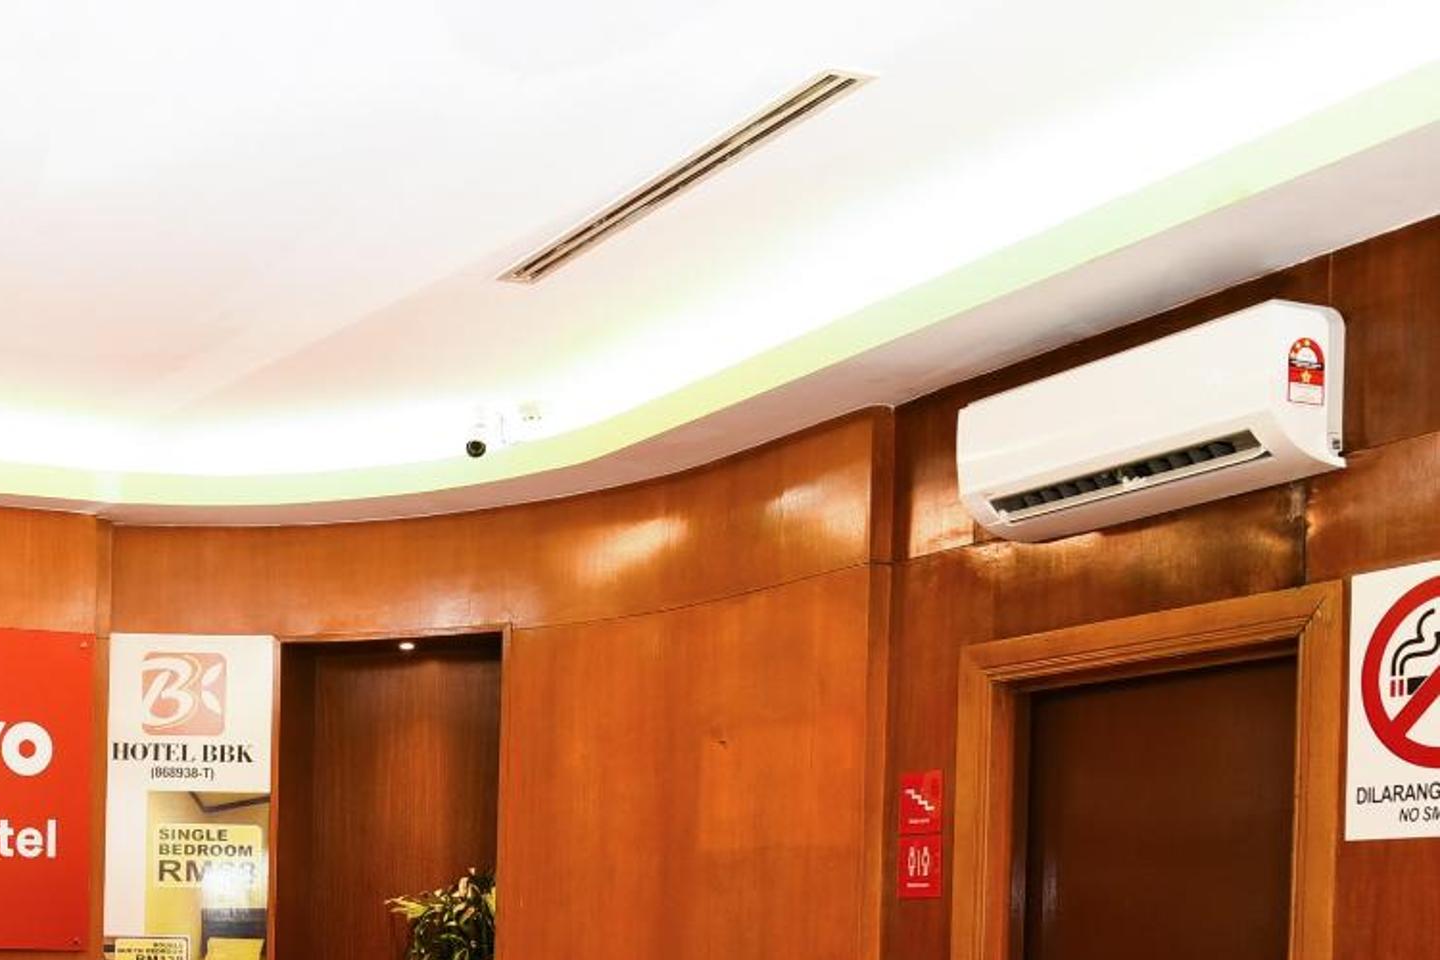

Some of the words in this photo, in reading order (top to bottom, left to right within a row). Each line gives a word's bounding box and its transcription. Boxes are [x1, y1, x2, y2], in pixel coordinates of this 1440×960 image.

[112, 742, 196, 762] HOTEL
[202, 744, 254, 763] BBK
[1356, 781, 1440, 805] DILARANG
[1399, 807, 1420, 822] NO
[158, 827, 229, 842] SINGLE
[158, 843, 254, 857] BEDROOM
